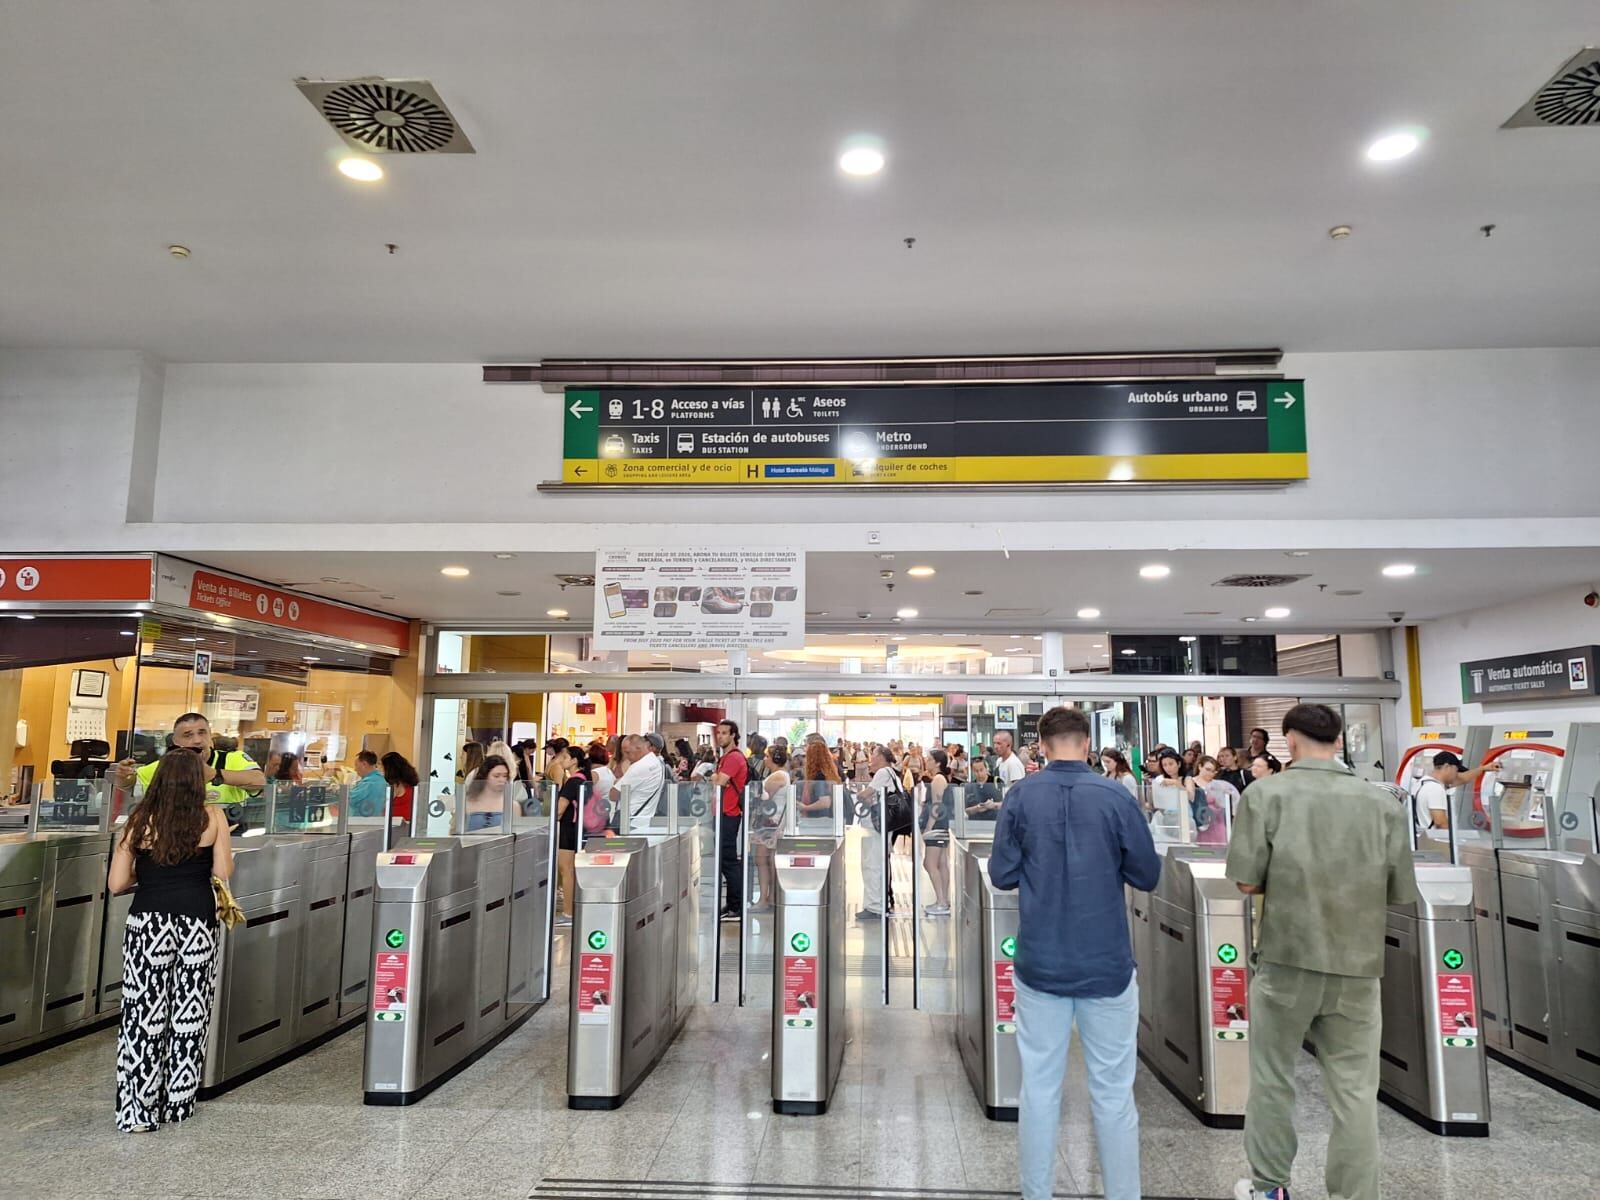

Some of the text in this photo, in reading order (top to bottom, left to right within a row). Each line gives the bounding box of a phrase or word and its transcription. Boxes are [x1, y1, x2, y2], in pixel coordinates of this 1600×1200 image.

[813, 397, 846, 407] Aseos
[1128, 391, 1228, 403] Autobús urbano
[632, 399, 664, 419] 1-8
[671, 400, 708, 410] Acceso
[722, 398, 745, 409] vías
[632, 432, 660, 443] Taxis
[702, 432, 830, 443] Estación de autobuses
[876, 432, 912, 442] Metro
[648, 464, 689, 472] comercial
[748, 464, 758, 478] H
[872, 464, 903, 472] lquiler
[198, 580, 252, 601] Venta de Billetes
[197, 592, 232, 607] Tickets Office
[1487, 661, 1563, 680] Venta automática
[1488, 684, 1513, 692] AUTOMATIC
[1531, 680, 1545, 688] SALES
